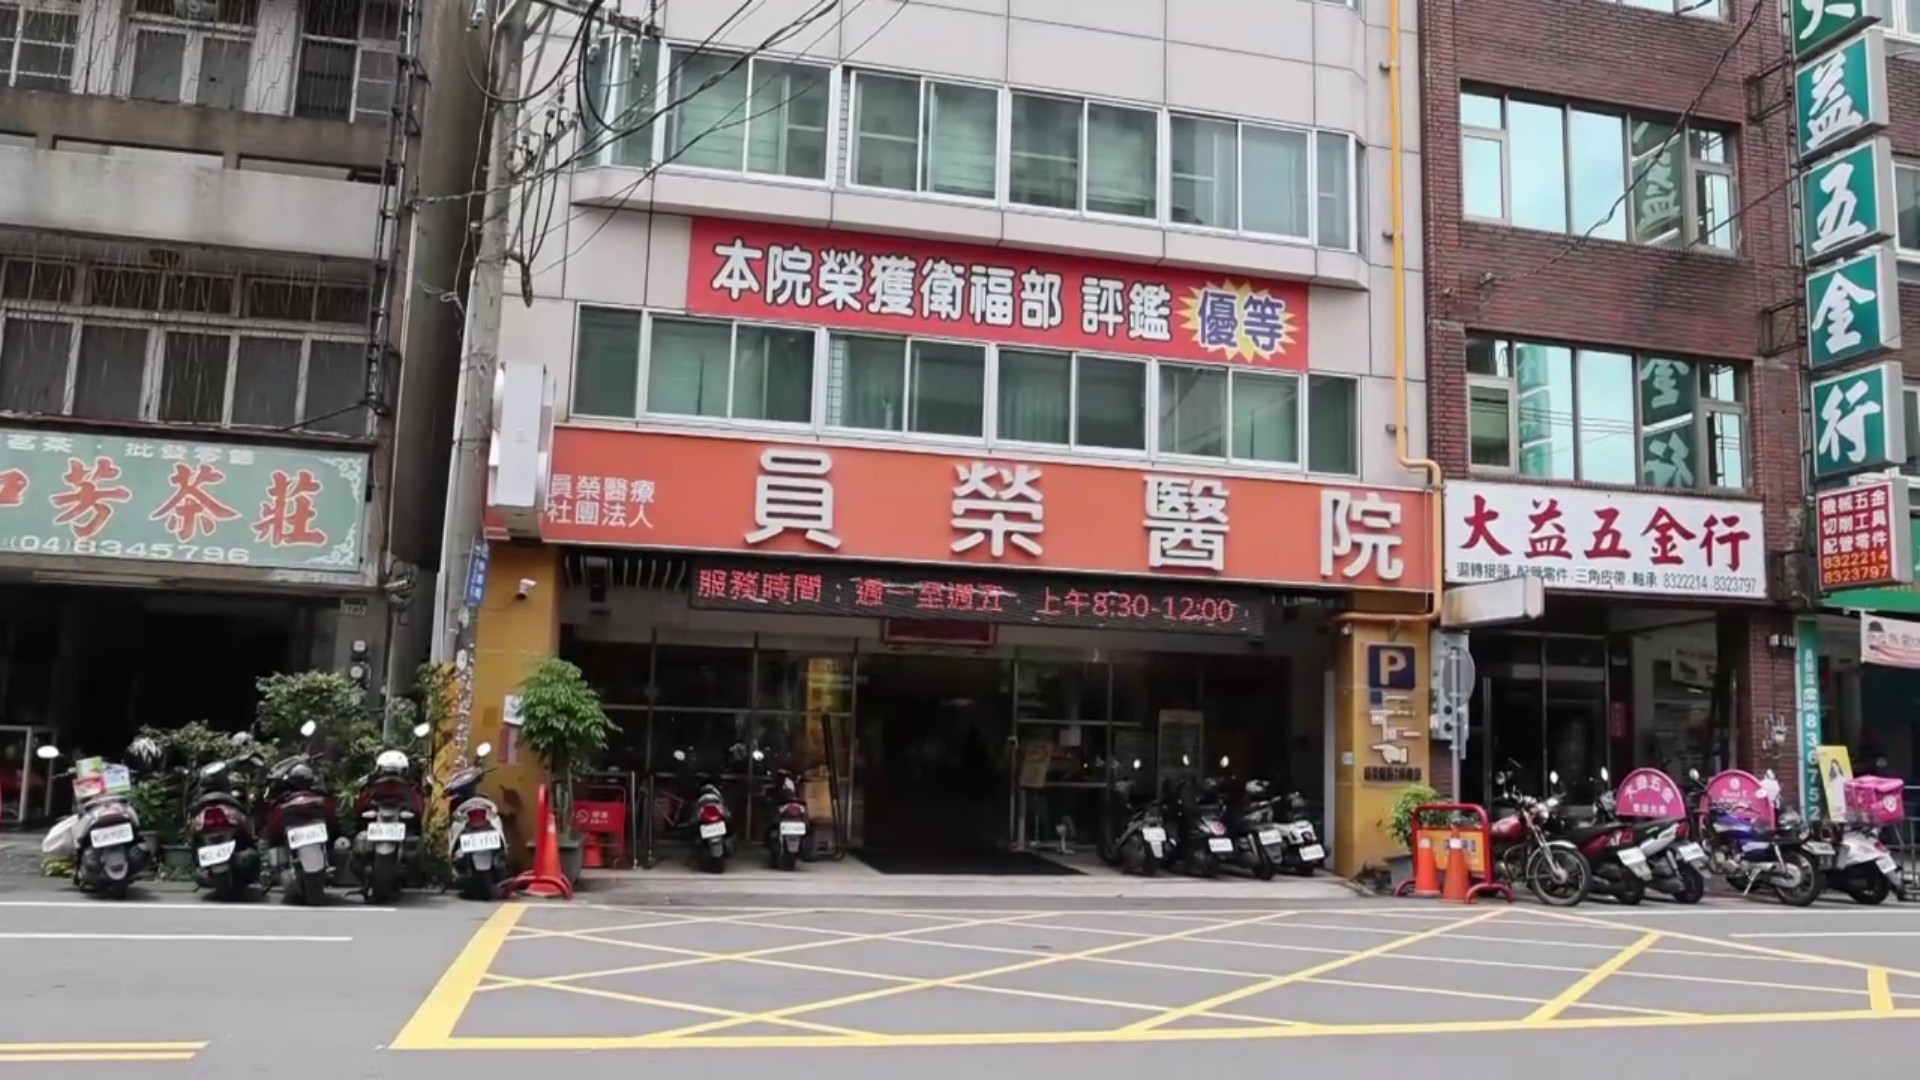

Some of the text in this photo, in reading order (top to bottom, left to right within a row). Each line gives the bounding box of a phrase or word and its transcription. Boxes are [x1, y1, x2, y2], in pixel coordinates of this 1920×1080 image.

[710, 237, 1285, 353] 本院榮獲衛福部 評鑑 優等
[548, 474, 656, 504] 員榮醫療
[1822, 490, 1887, 515] 機械五金
[547, 499, 654, 530] 社團法人
[743, 448, 1405, 581] 員榮醫院
[1822, 509, 1887, 536] 切削工具
[1460, 494, 1750, 572] 大益五金行
[1823, 531, 1888, 555] 配管零件
[1823, 548, 1888, 569] 8322214
[1663, 572, 1708, 590] 8322214
[1713, 575, 1756, 592] 8323797
[1823, 565, 1889, 585] 8323797
[1379, 649, 1407, 685] P
